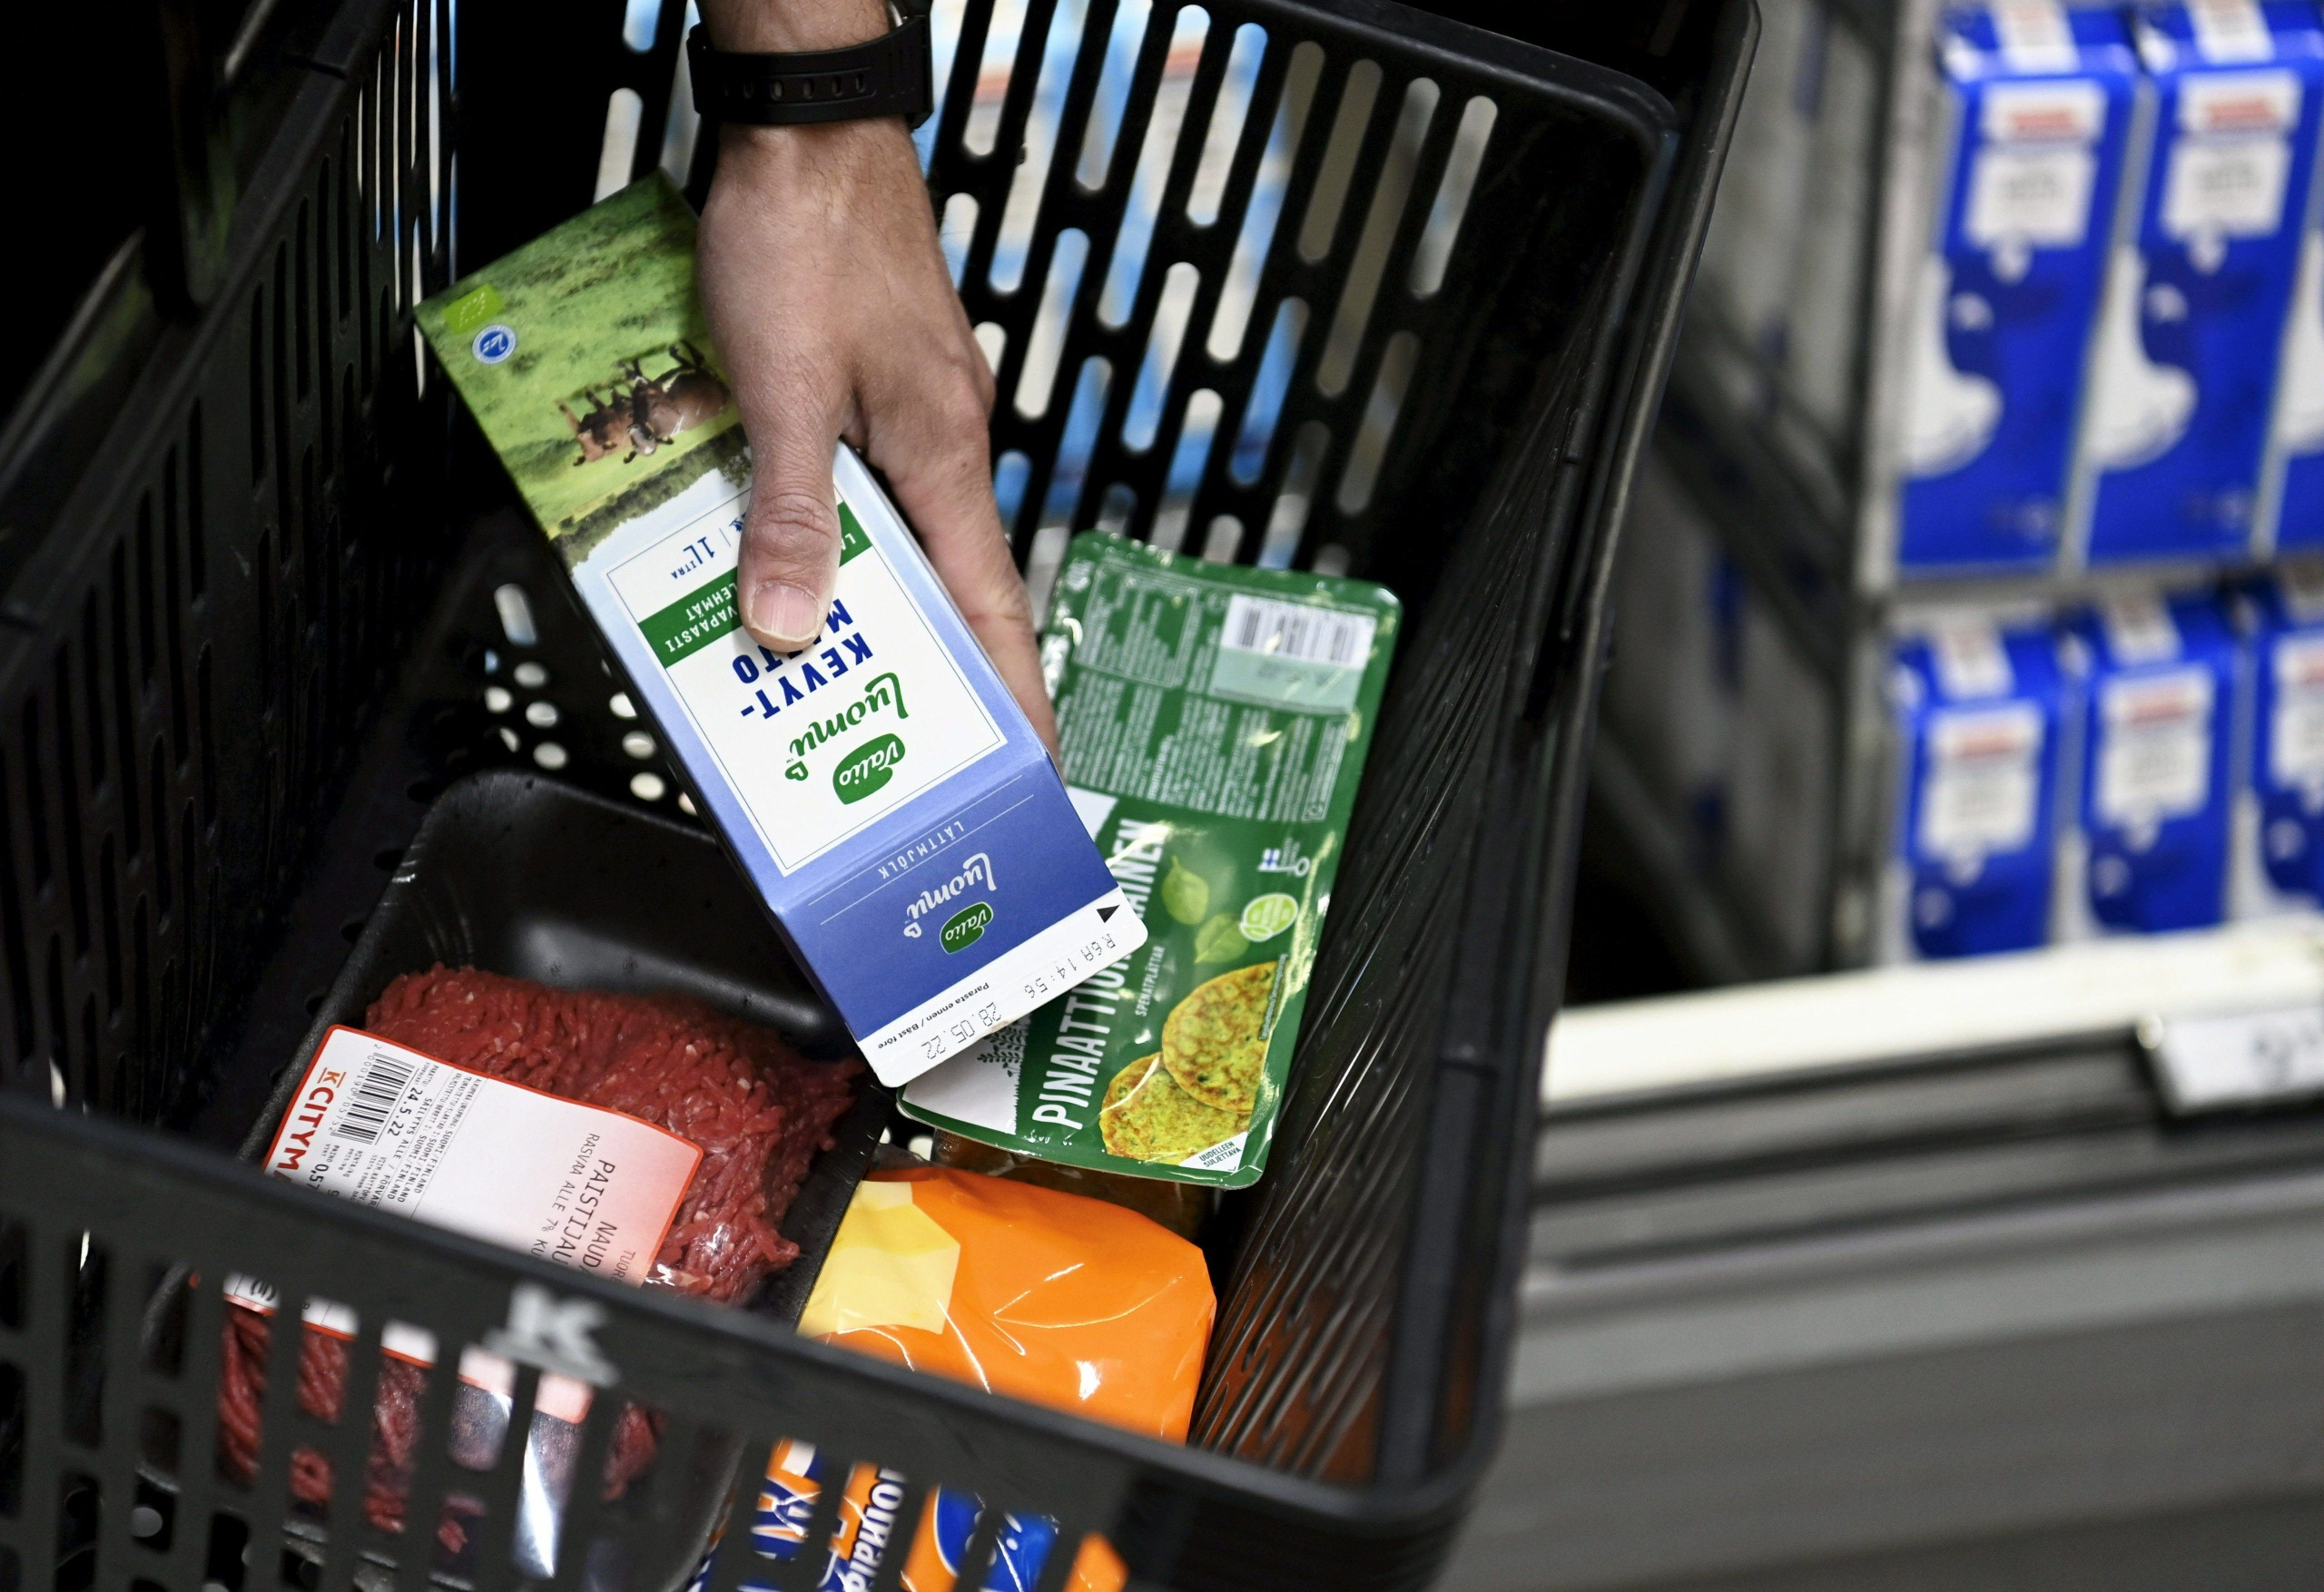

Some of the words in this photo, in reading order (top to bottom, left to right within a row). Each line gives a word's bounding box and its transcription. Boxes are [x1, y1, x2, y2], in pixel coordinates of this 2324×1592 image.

[683, 581, 739, 622] LEHMÄT
[664, 604, 735, 652] VAPAASTI
[739, 632, 873, 719] KEVYT-
[784, 669, 909, 762] Luomu
[835, 741, 902, 787] Valio
[877, 820, 965, 880] LÄTTMJÖLK
[904, 850, 997, 920] Luomu
[943, 909, 990, 944] Valio
[954, 982, 989, 1006] Parasta
[1023, 957, 1078, 999] 14:56
[1135, 945, 1165, 1017] SPENATPLÄTTAR
[897, 1022, 919, 1038] Bäst
[921, 1002, 1002, 1059] 28.05.22
[925, 1002, 953, 1021] ennen
[877, 1035, 898, 1050] före
[387, 1086, 422, 1136] 24.5.22
[325, 1145, 339, 1163] PAINO
[386, 1134, 426, 1200] SUOMI/FINLAND
[392, 1138, 409, 1160] ALLE
[413, 1130, 452, 1194] SUOMI/FINLAND
[569, 1132, 599, 1177] RASVAA
[1198, 1141, 1235, 1161] UUDELLEEN
[1203, 1146, 1241, 1167] SULJETTAVA
[367, 1174, 392, 1208] FÖRVAR
[552, 1180, 576, 1212] ALLE
[541, 1217, 557, 1233] 7%
